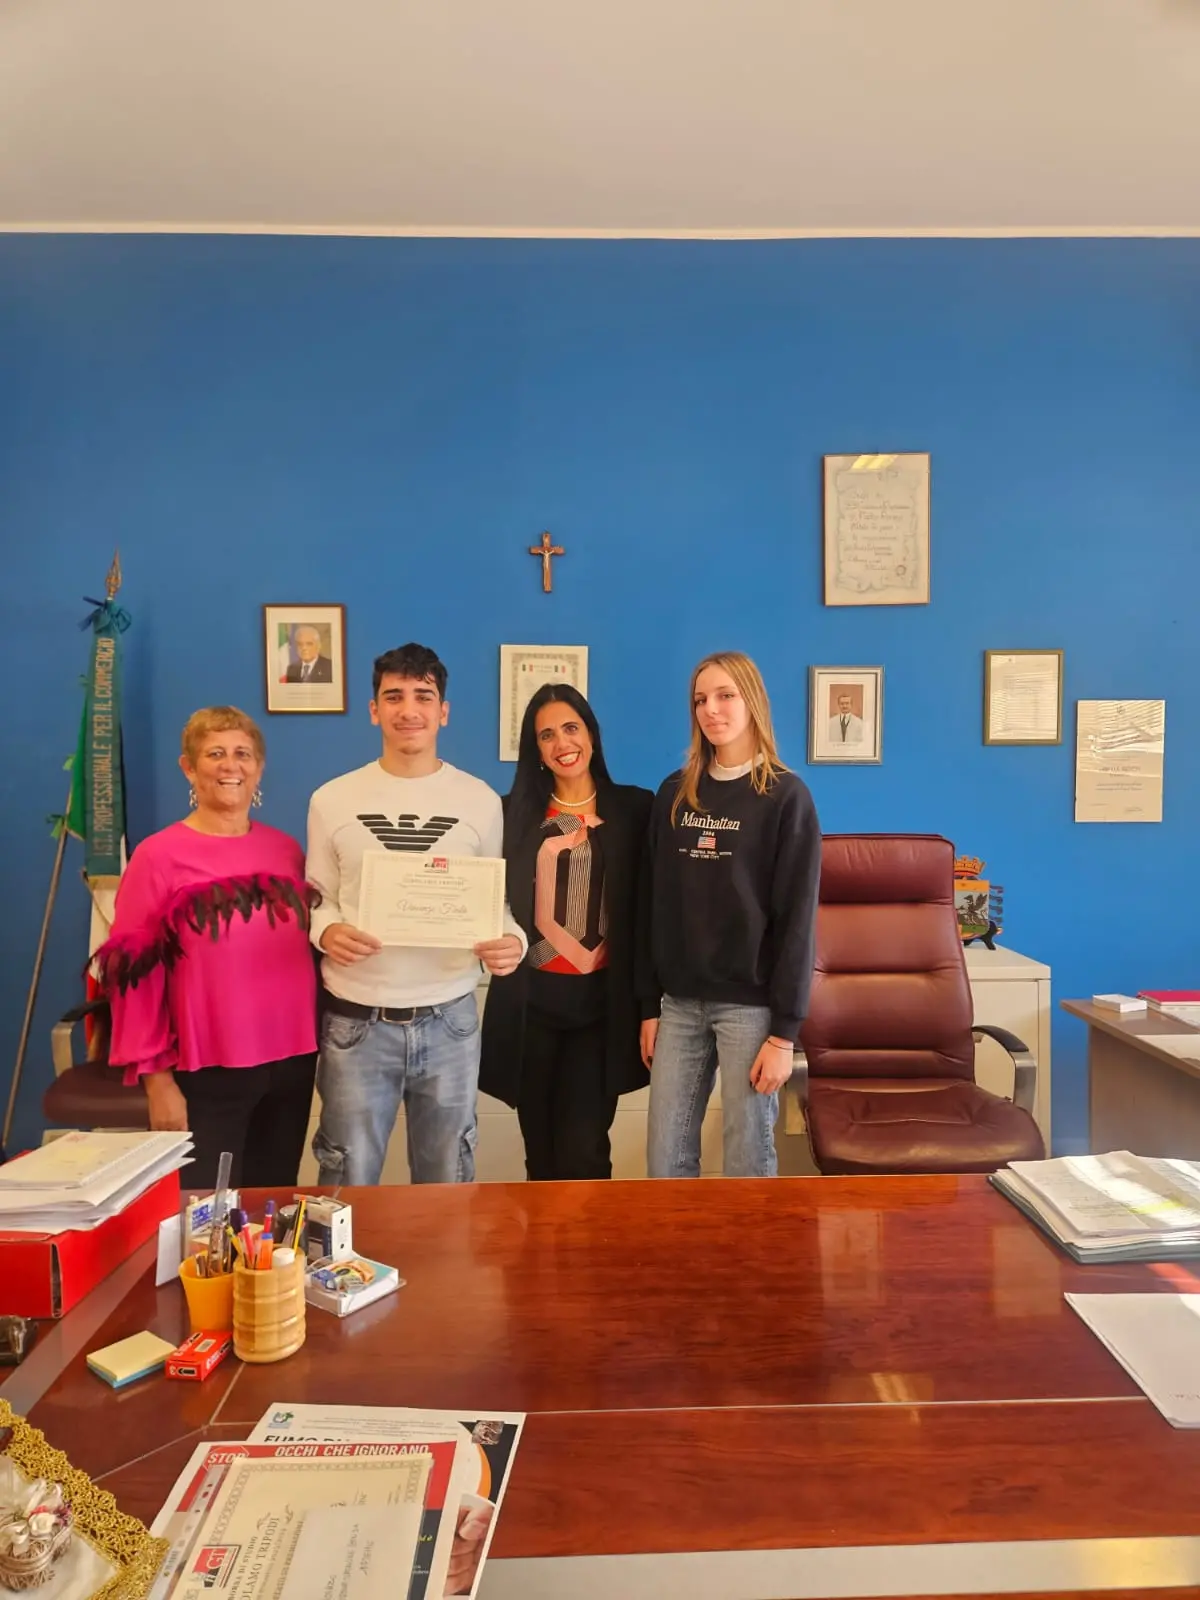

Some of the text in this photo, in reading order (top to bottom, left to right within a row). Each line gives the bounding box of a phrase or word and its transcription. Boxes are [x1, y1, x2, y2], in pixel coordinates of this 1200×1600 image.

[94, 637, 115, 699] COMMERCIO
[93, 700, 113, 711] IL
[92, 714, 113, 737] PER
[92, 742, 113, 833] PROFESSIONALE
[681, 811, 741, 831] Manhattan
[274, 1444, 429, 1457] OCCHI CHE IGNORANO
[255, 1517, 280, 1560] TRIPODI
